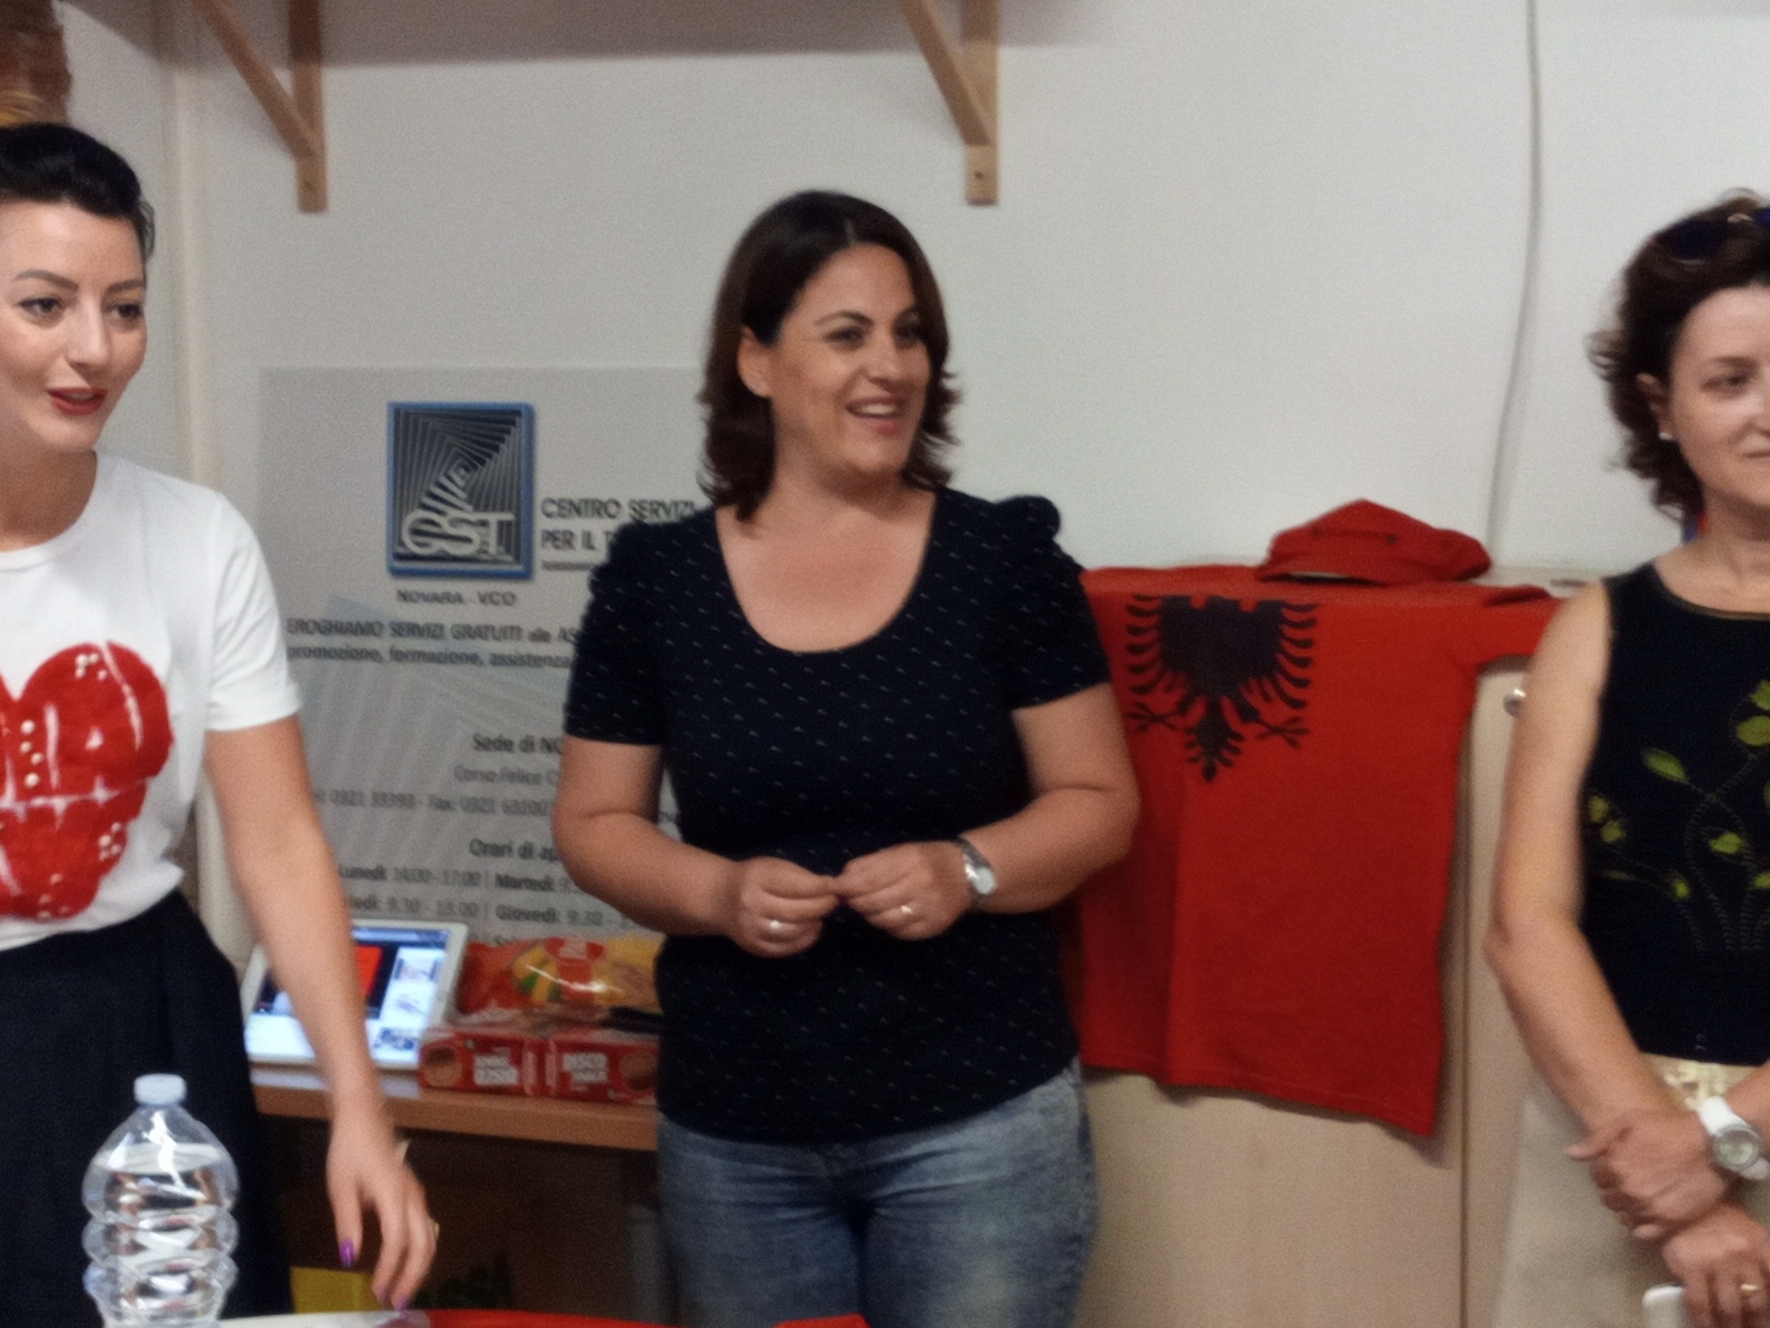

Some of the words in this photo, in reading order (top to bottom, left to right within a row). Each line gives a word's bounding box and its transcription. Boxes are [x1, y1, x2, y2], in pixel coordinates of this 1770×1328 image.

[542, 497, 621, 520] CENTRO
[541, 530, 575, 550] PER
[582, 531, 596, 550] IL
[396, 589, 464, 605] NOVARA
[477, 591, 517, 607] VCO
[389, 621, 445, 640] SERVIZI
[472, 733, 515, 754] Sede
[519, 734, 536, 754] di
[469, 838, 513, 858] Orari
[517, 841, 533, 861] di
